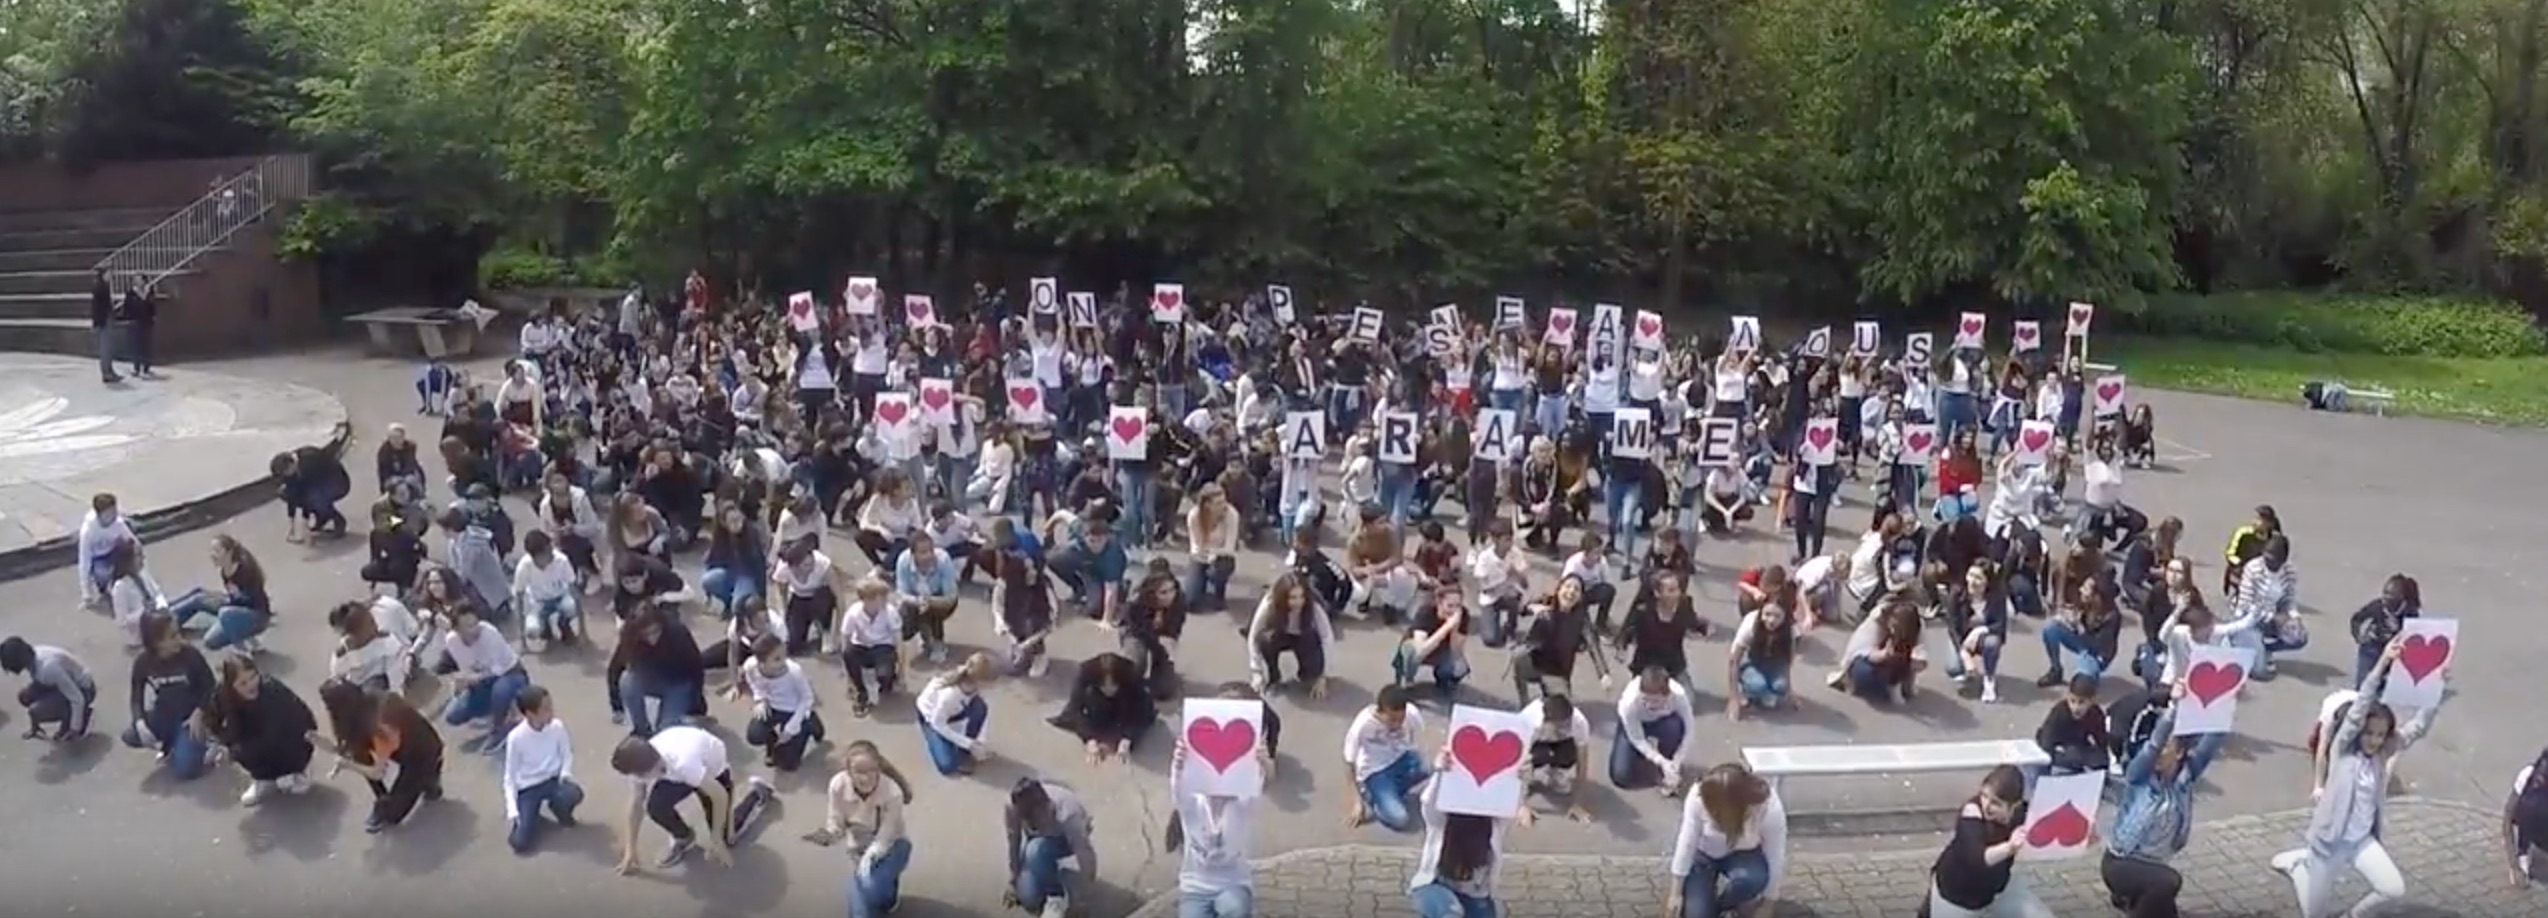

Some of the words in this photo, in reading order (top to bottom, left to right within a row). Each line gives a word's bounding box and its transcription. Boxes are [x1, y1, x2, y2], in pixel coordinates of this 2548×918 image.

[1035, 283, 1053, 309] O
[1071, 295, 1094, 324] N
[1271, 289, 1288, 321] P
[1354, 311, 1379, 337] E
[1499, 301, 1521, 326] E
[1596, 309, 1615, 341] A
[1429, 328, 1452, 352] S
[1808, 332, 1827, 356] O
[1858, 327, 1876, 352] U
[1910, 338, 1930, 363] S
[1293, 417, 1320, 455] A
[1383, 416, 1412, 456] R
[1480, 414, 1506, 456] A
[1617, 419, 1649, 449] M
[1703, 423, 1733, 460] E
